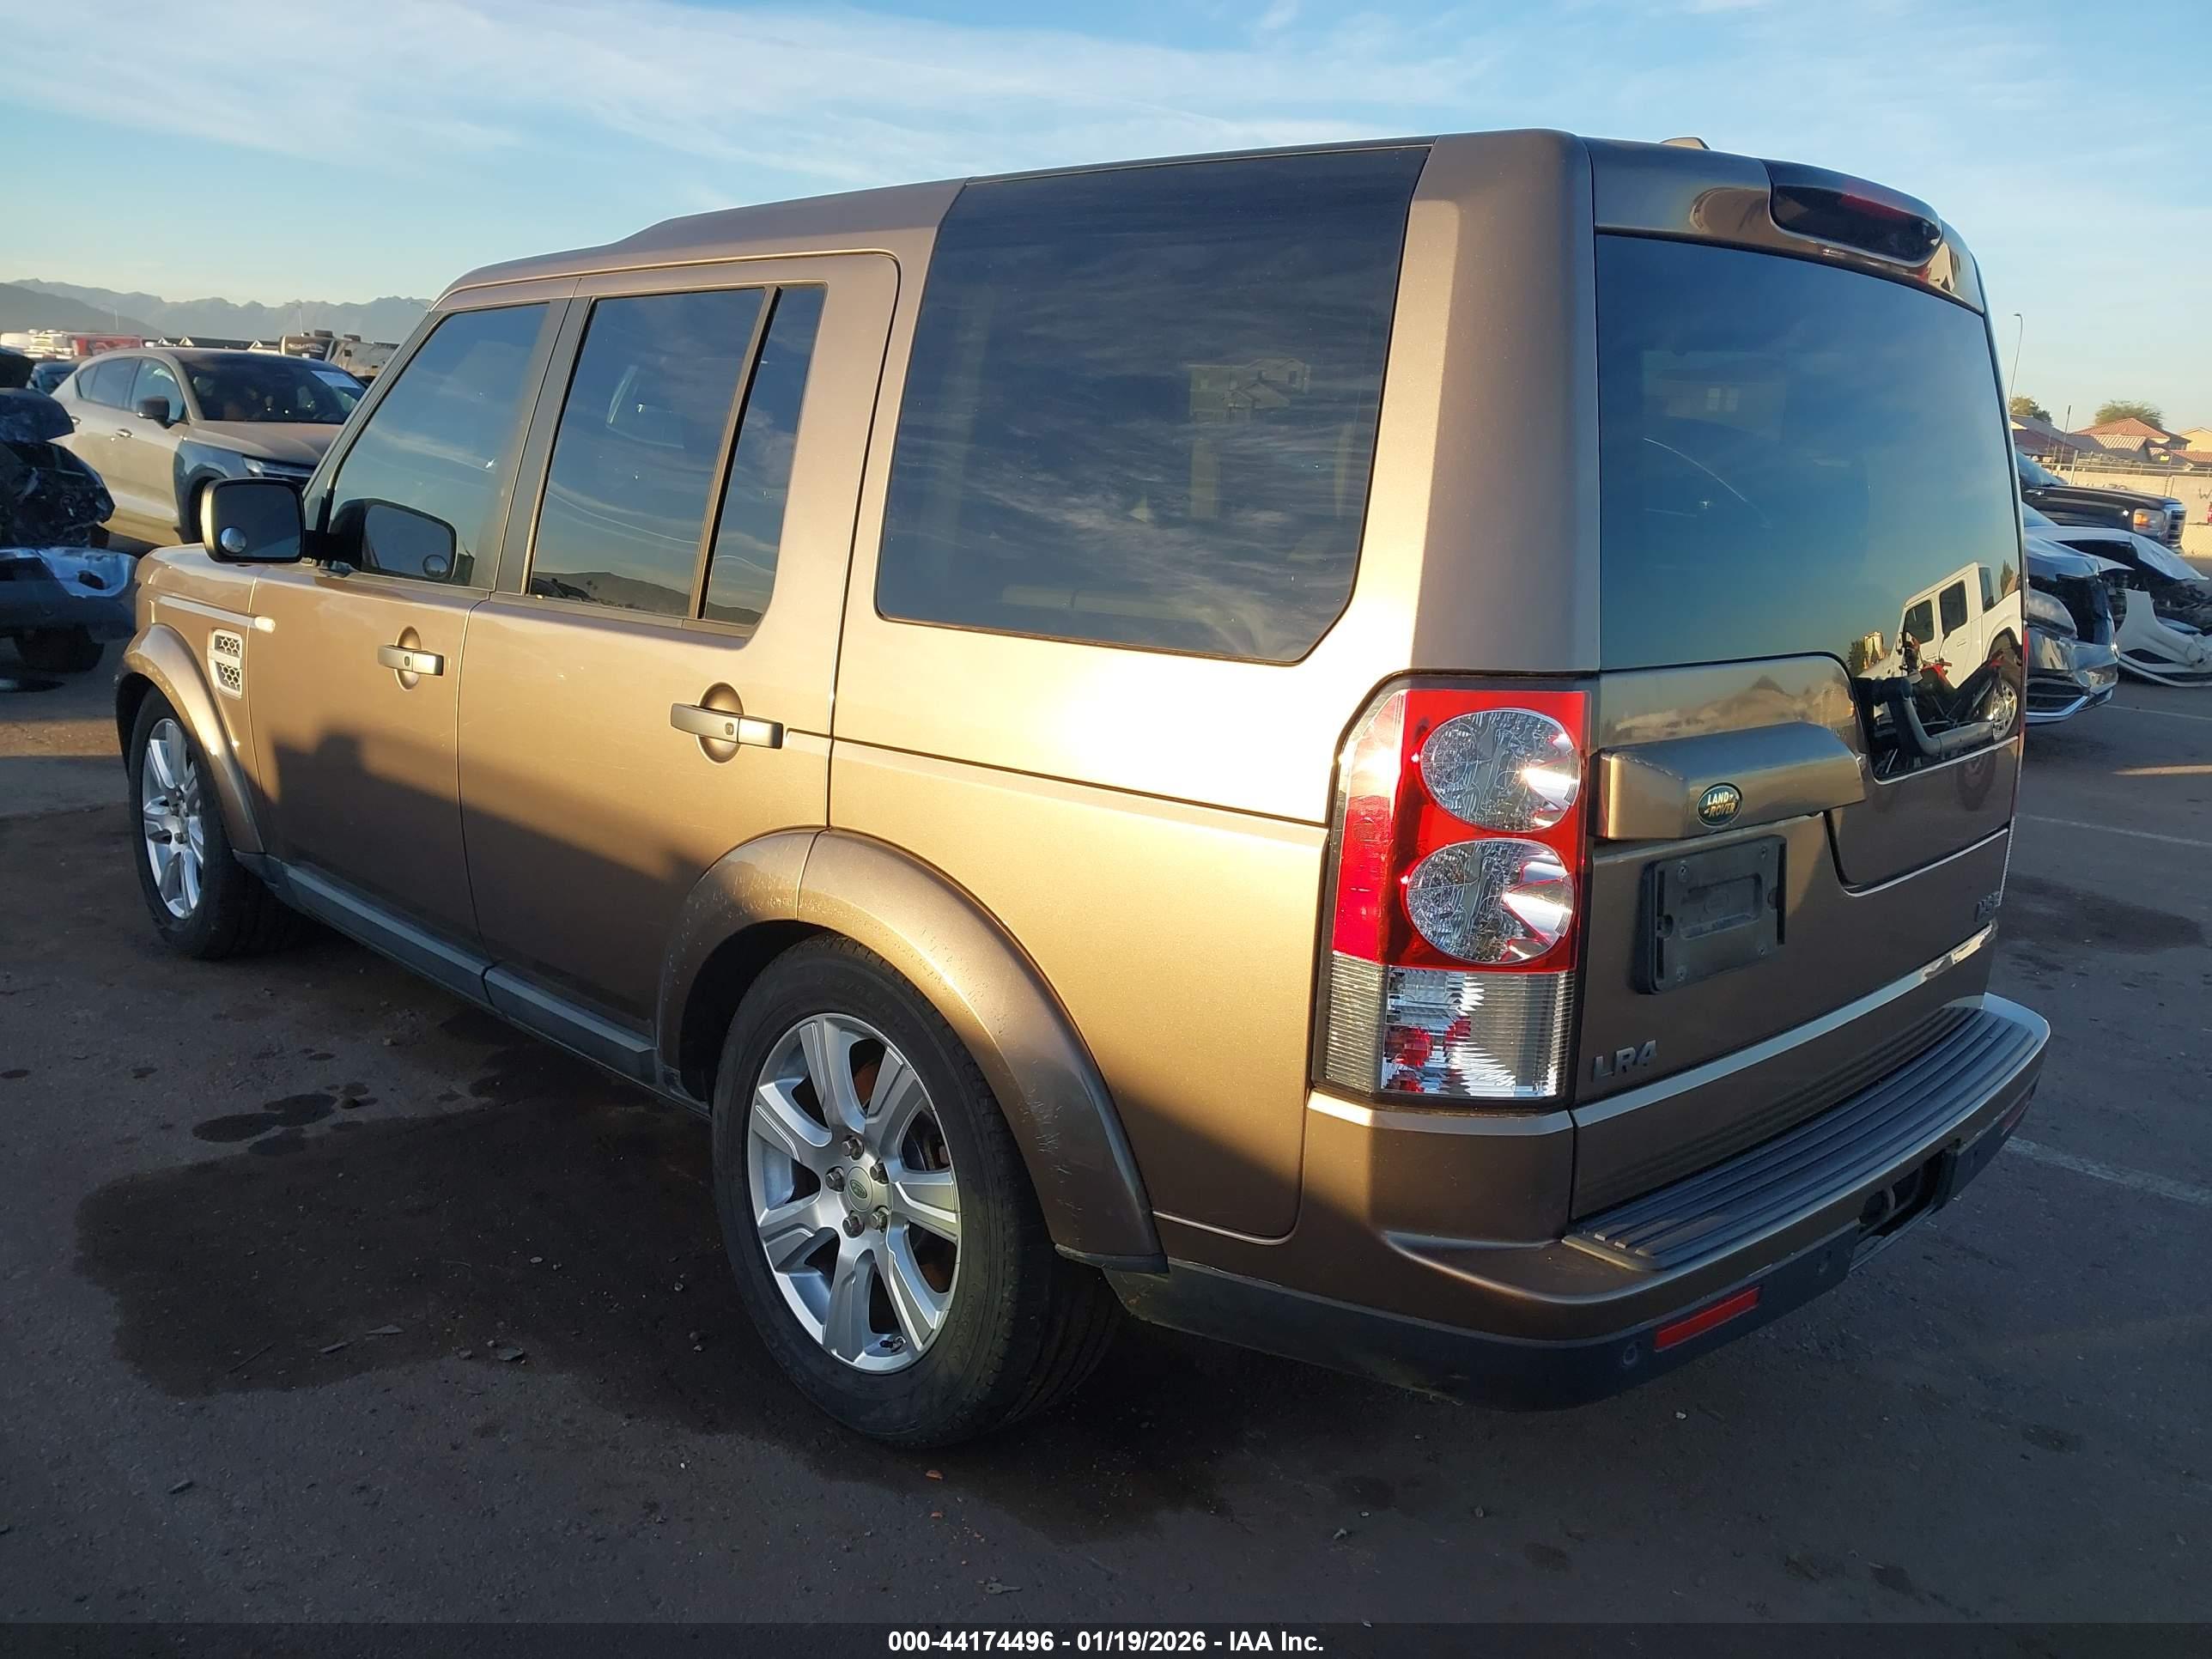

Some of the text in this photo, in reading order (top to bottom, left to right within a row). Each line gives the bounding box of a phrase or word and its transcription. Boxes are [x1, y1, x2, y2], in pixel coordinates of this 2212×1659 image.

[1707, 791, 1729, 805] LAND
[1709, 802, 1735, 817] ROVER
[1592, 1039, 1657, 1084] LR4
